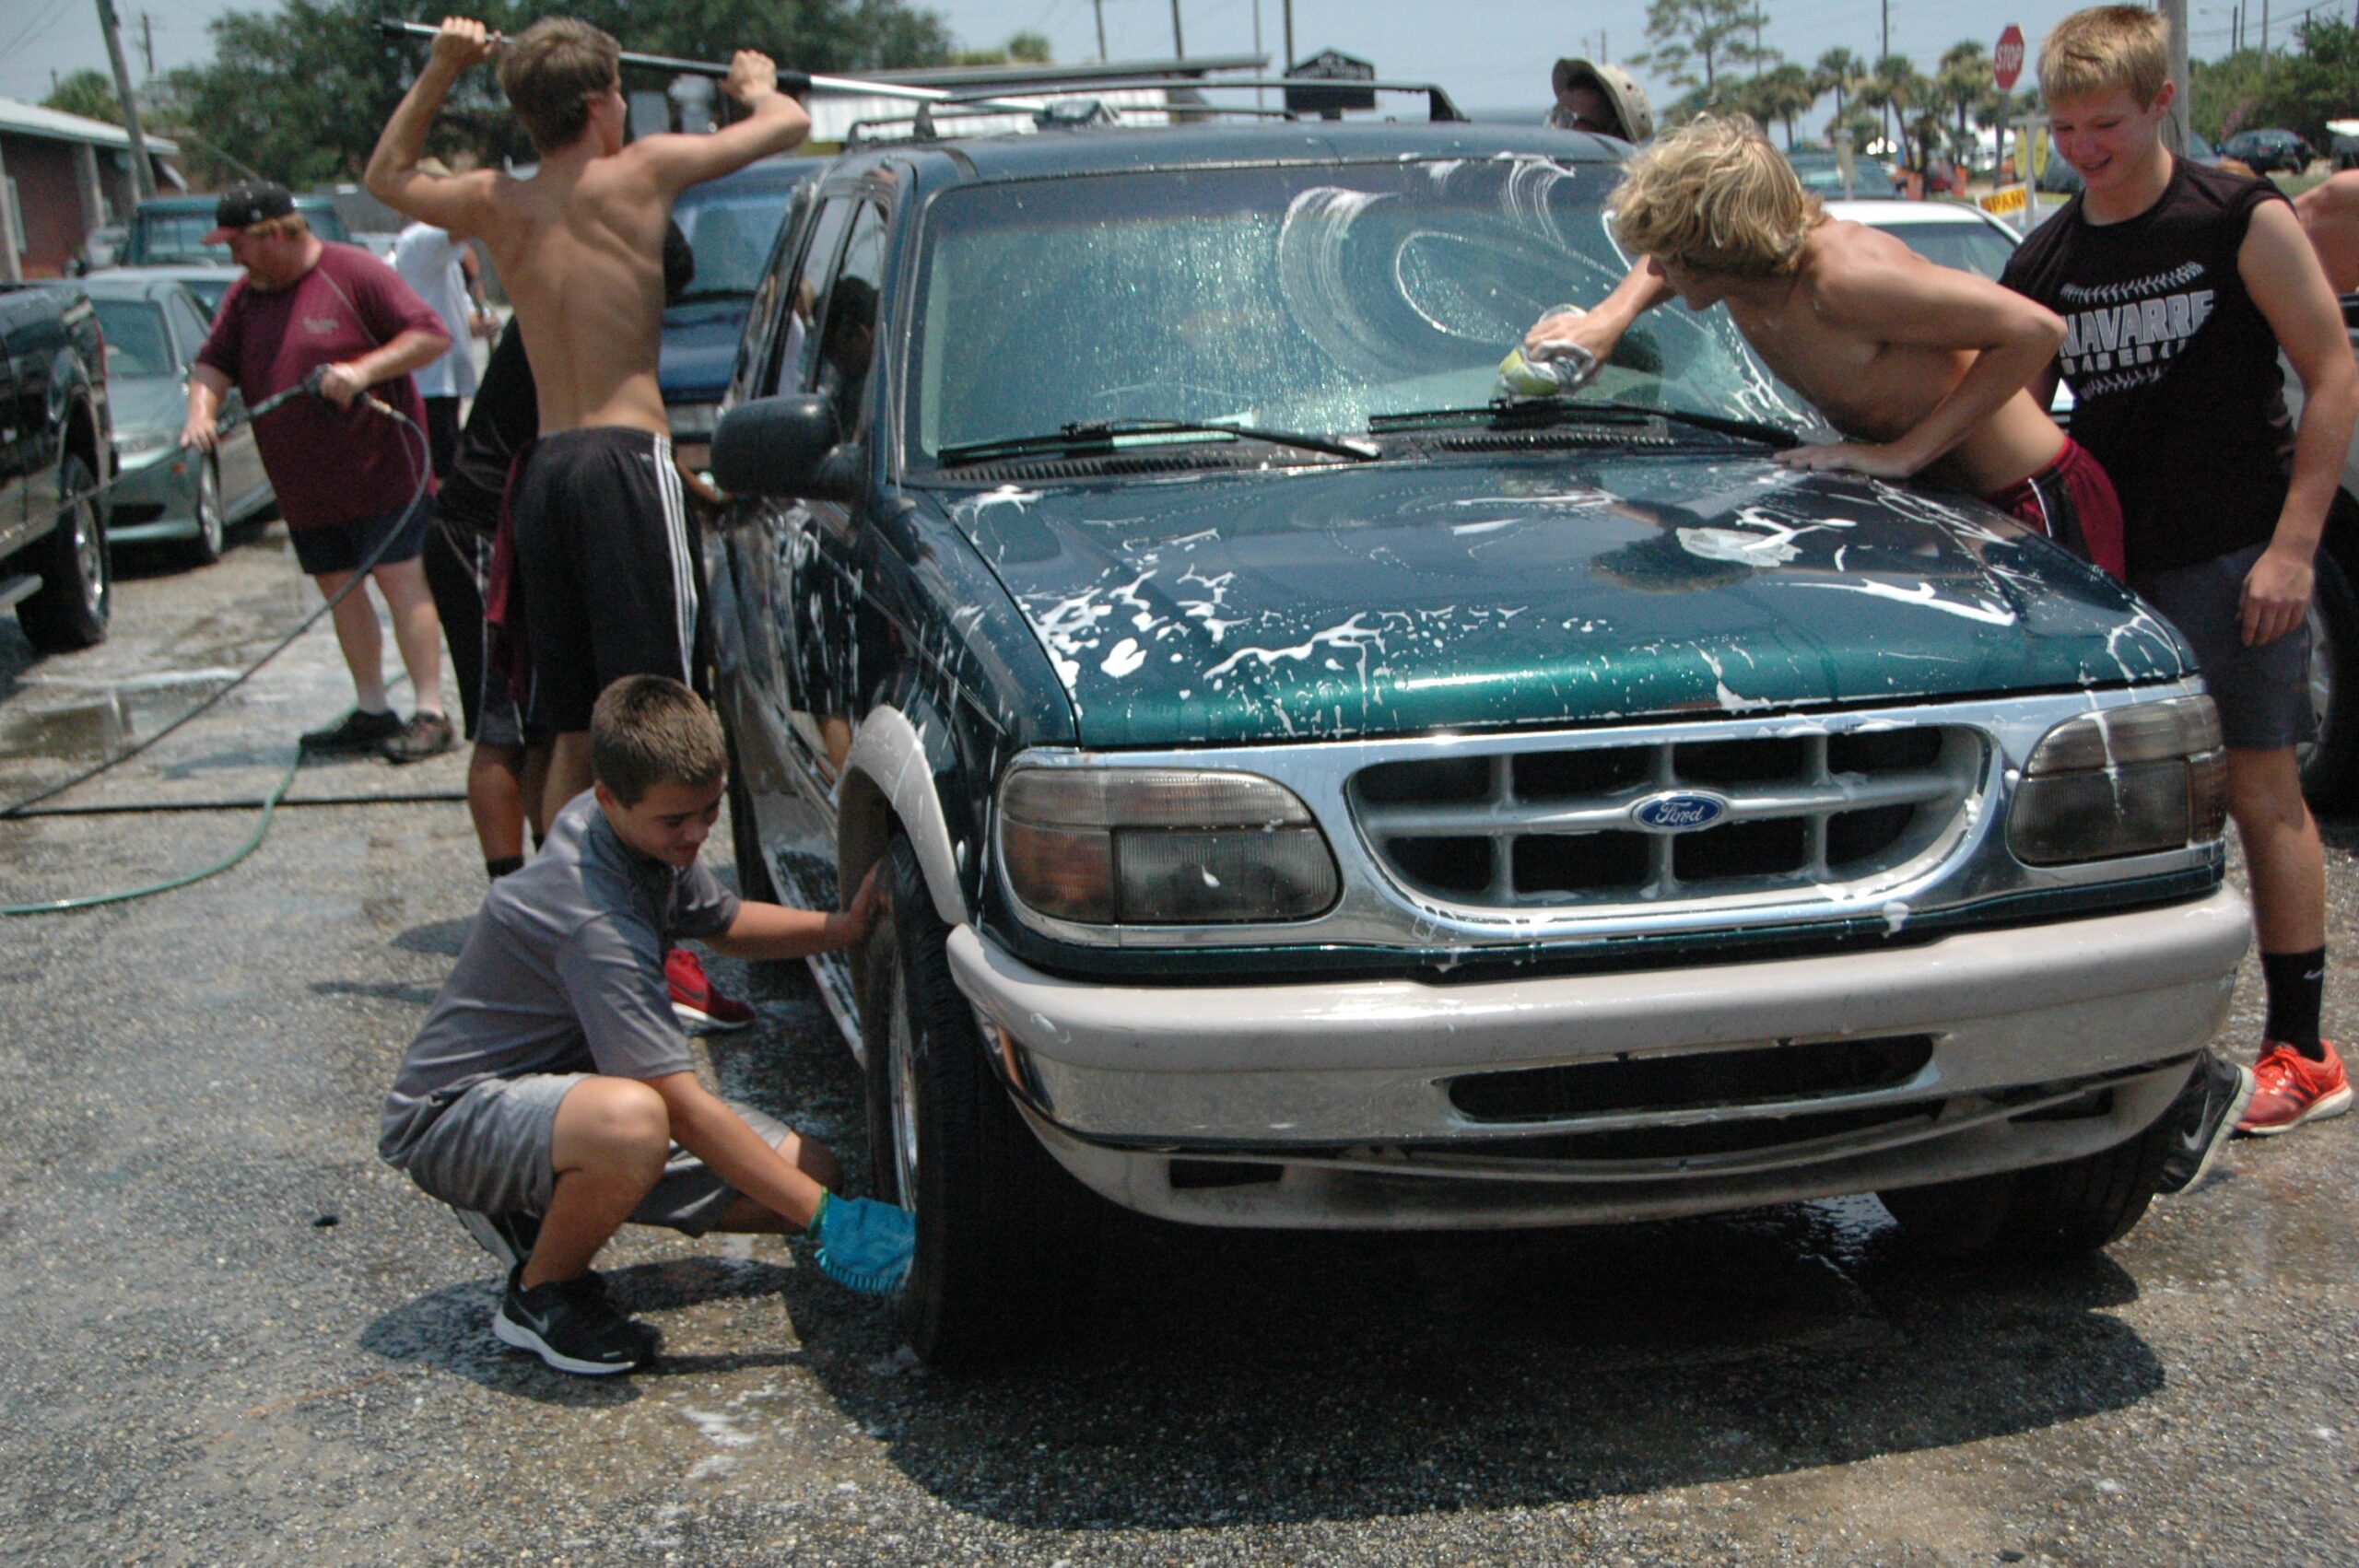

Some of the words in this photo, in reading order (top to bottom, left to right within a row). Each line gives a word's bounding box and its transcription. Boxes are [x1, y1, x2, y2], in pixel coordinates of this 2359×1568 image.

[1995, 43, 2023, 73] STOP
[2059, 290, 2213, 357] NAVARRE
[1655, 802, 1704, 824] Ford
